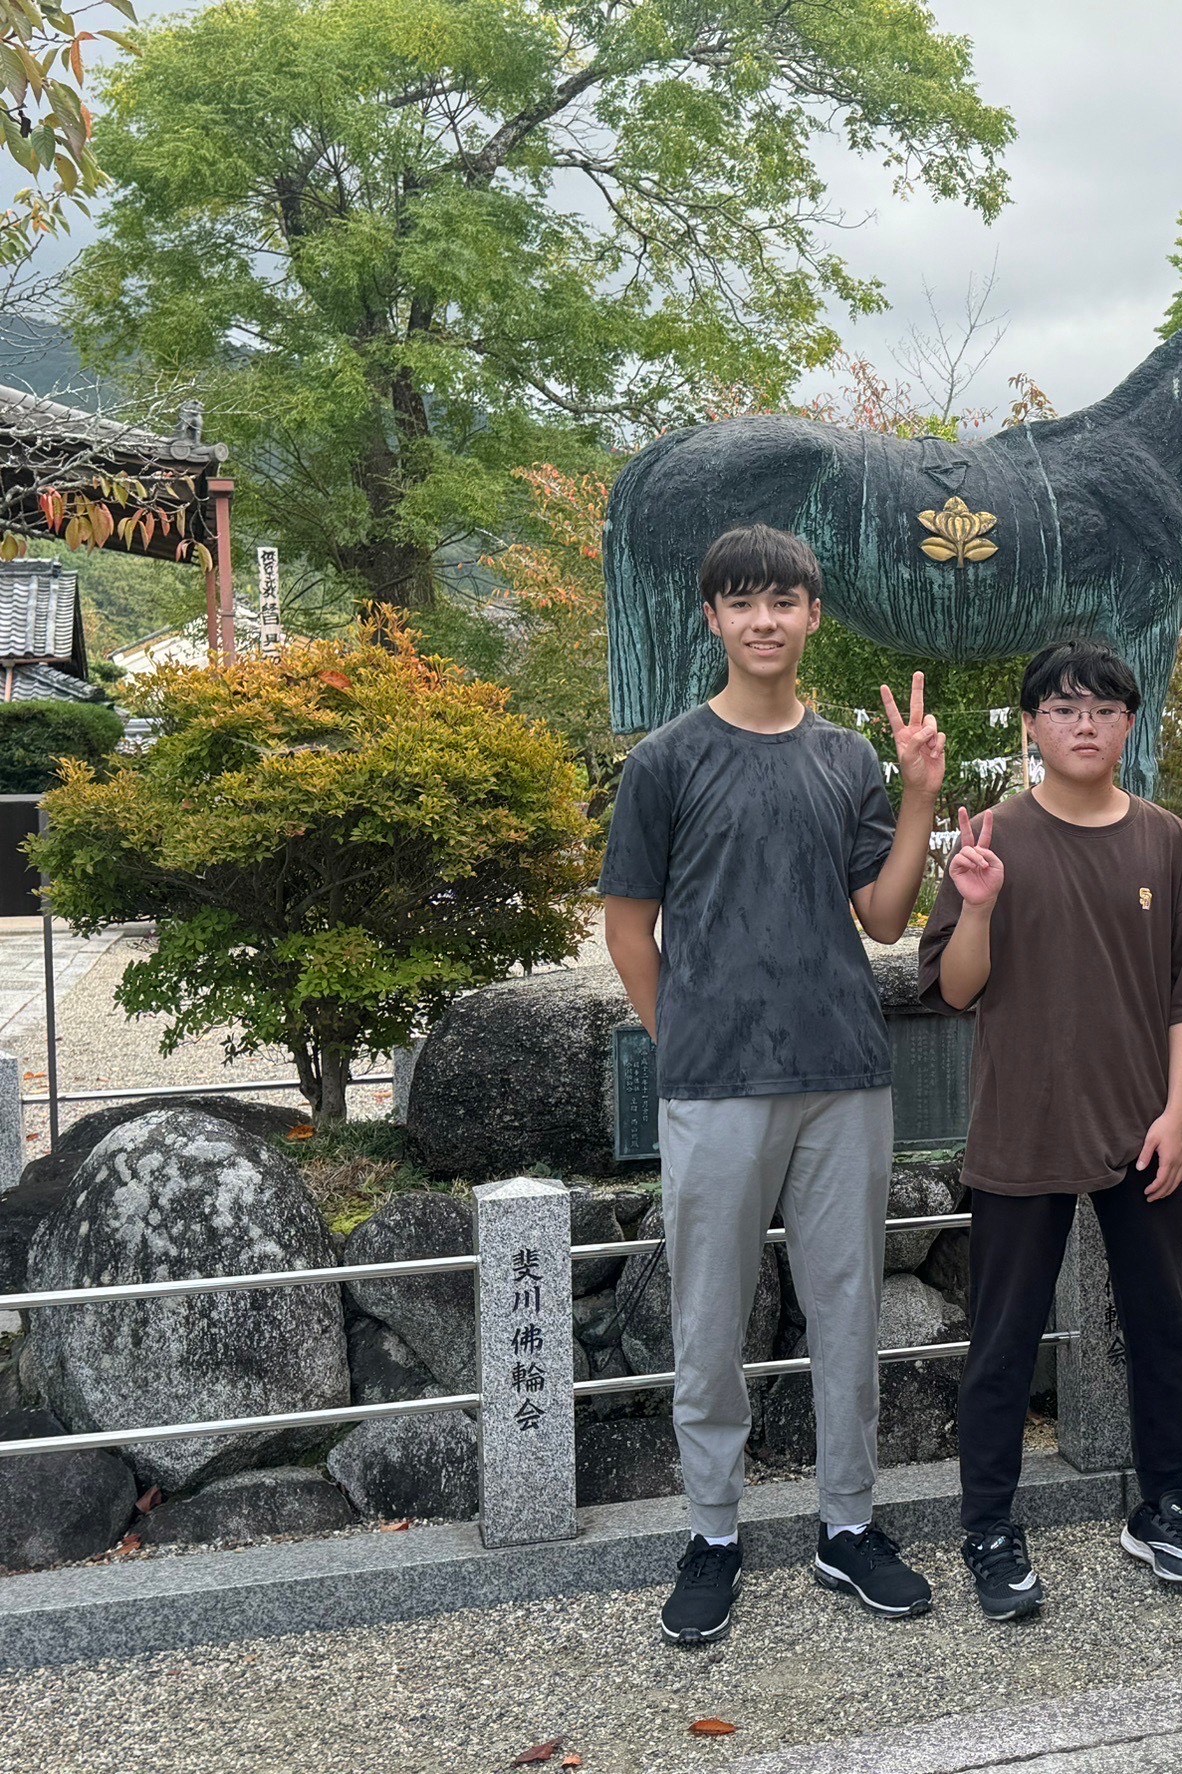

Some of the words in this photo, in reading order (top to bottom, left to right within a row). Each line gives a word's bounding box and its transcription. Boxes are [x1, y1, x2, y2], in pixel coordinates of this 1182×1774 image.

[511, 1249, 546, 1431] 斐川佛輪会
